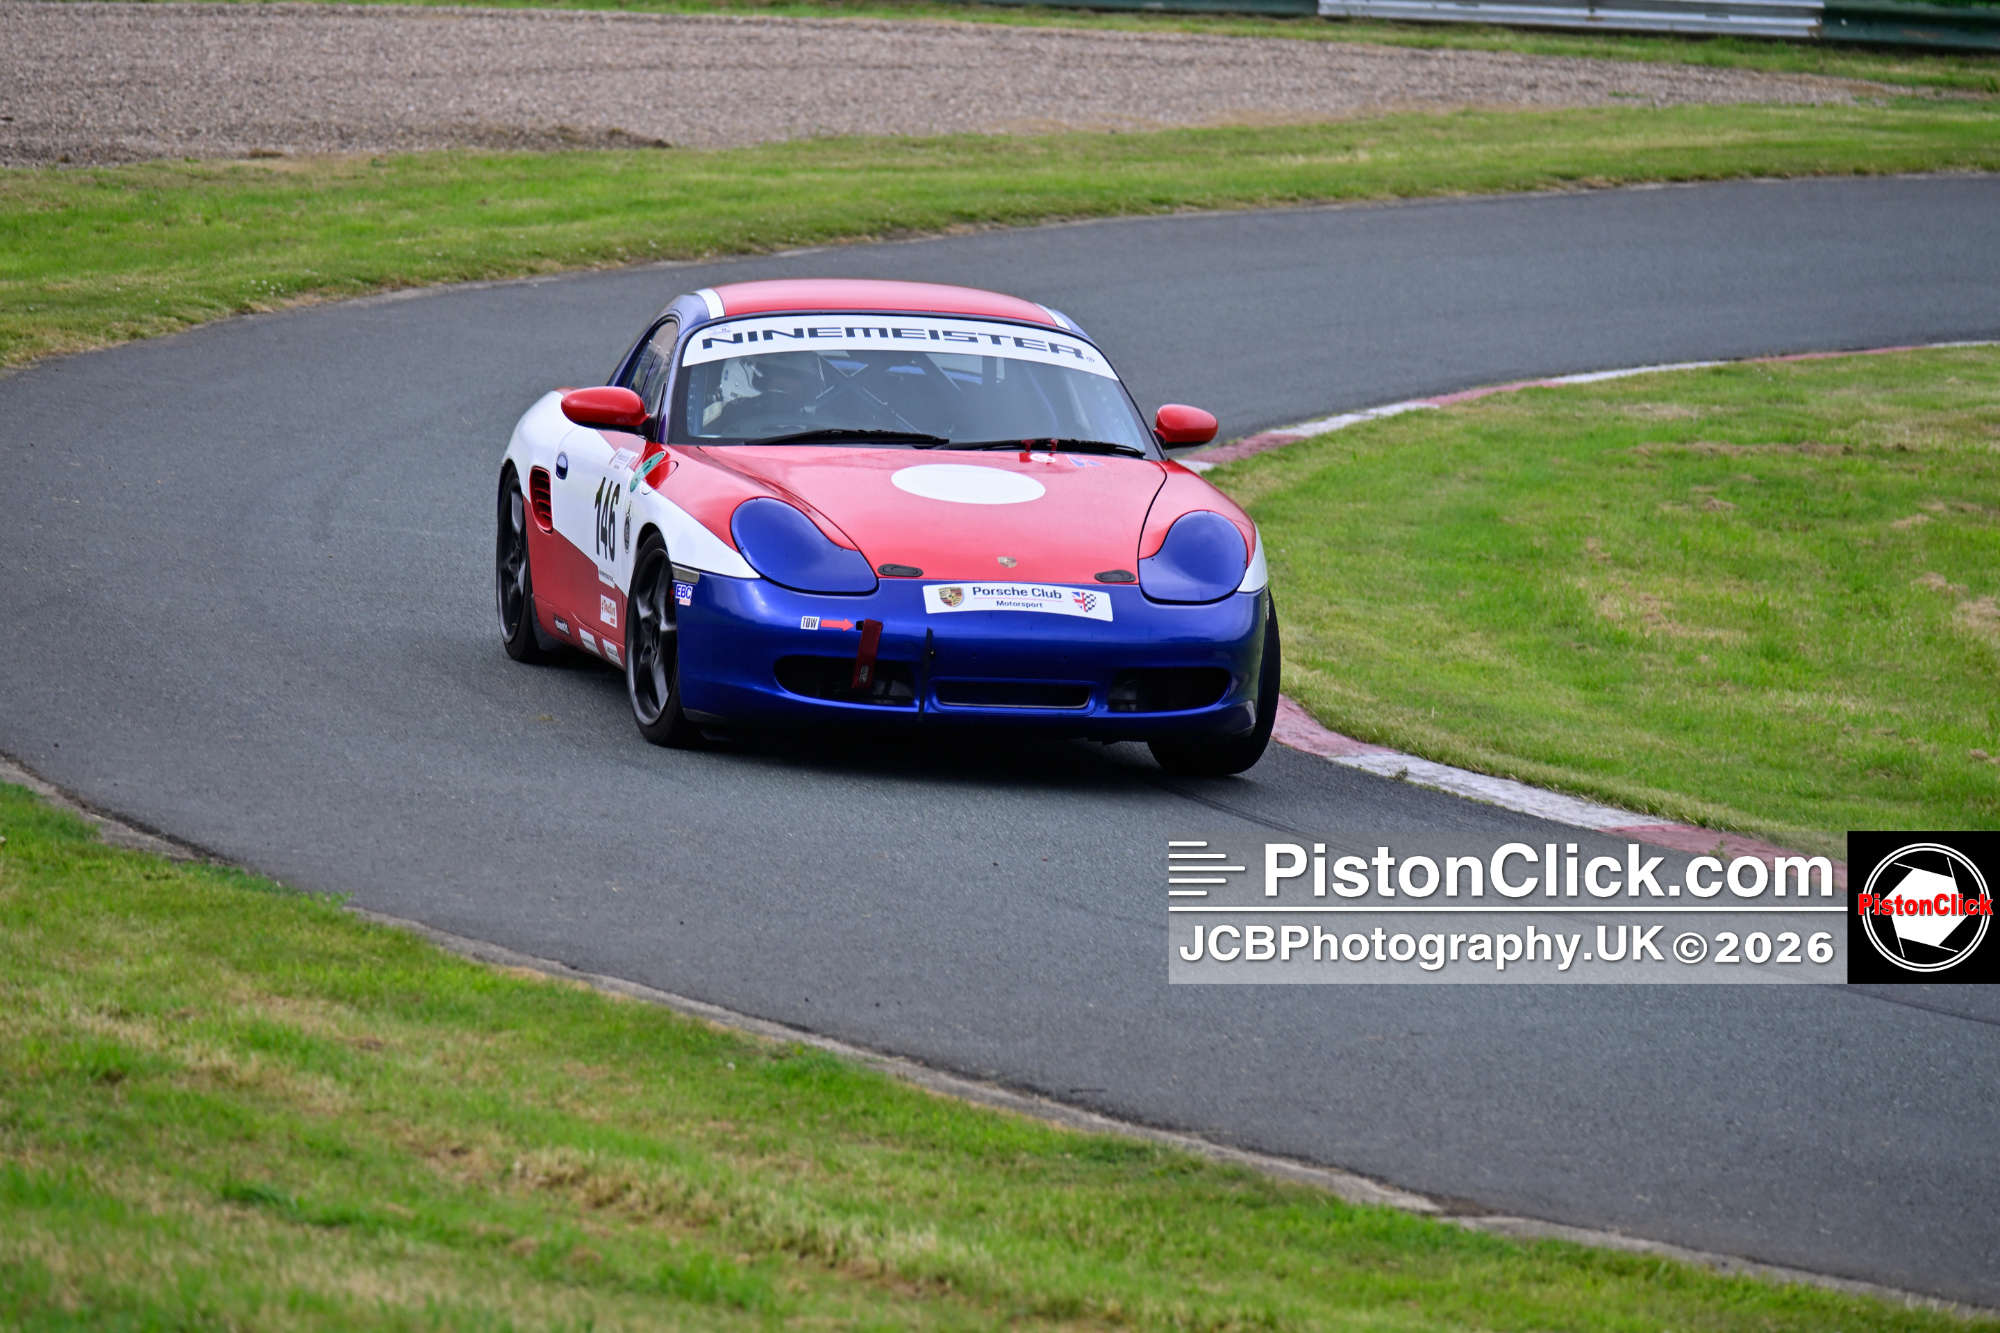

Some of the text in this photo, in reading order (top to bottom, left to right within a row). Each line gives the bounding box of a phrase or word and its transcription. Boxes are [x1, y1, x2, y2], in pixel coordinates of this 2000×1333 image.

[702, 327, 1084, 360] NINEMEISTER
[595, 477, 620, 562] 146
[676, 585, 692, 599] EBC
[972, 586, 1062, 600] Porsche Club
[997, 600, 1043, 609] Motorsport
[802, 617, 818, 629] TOW
